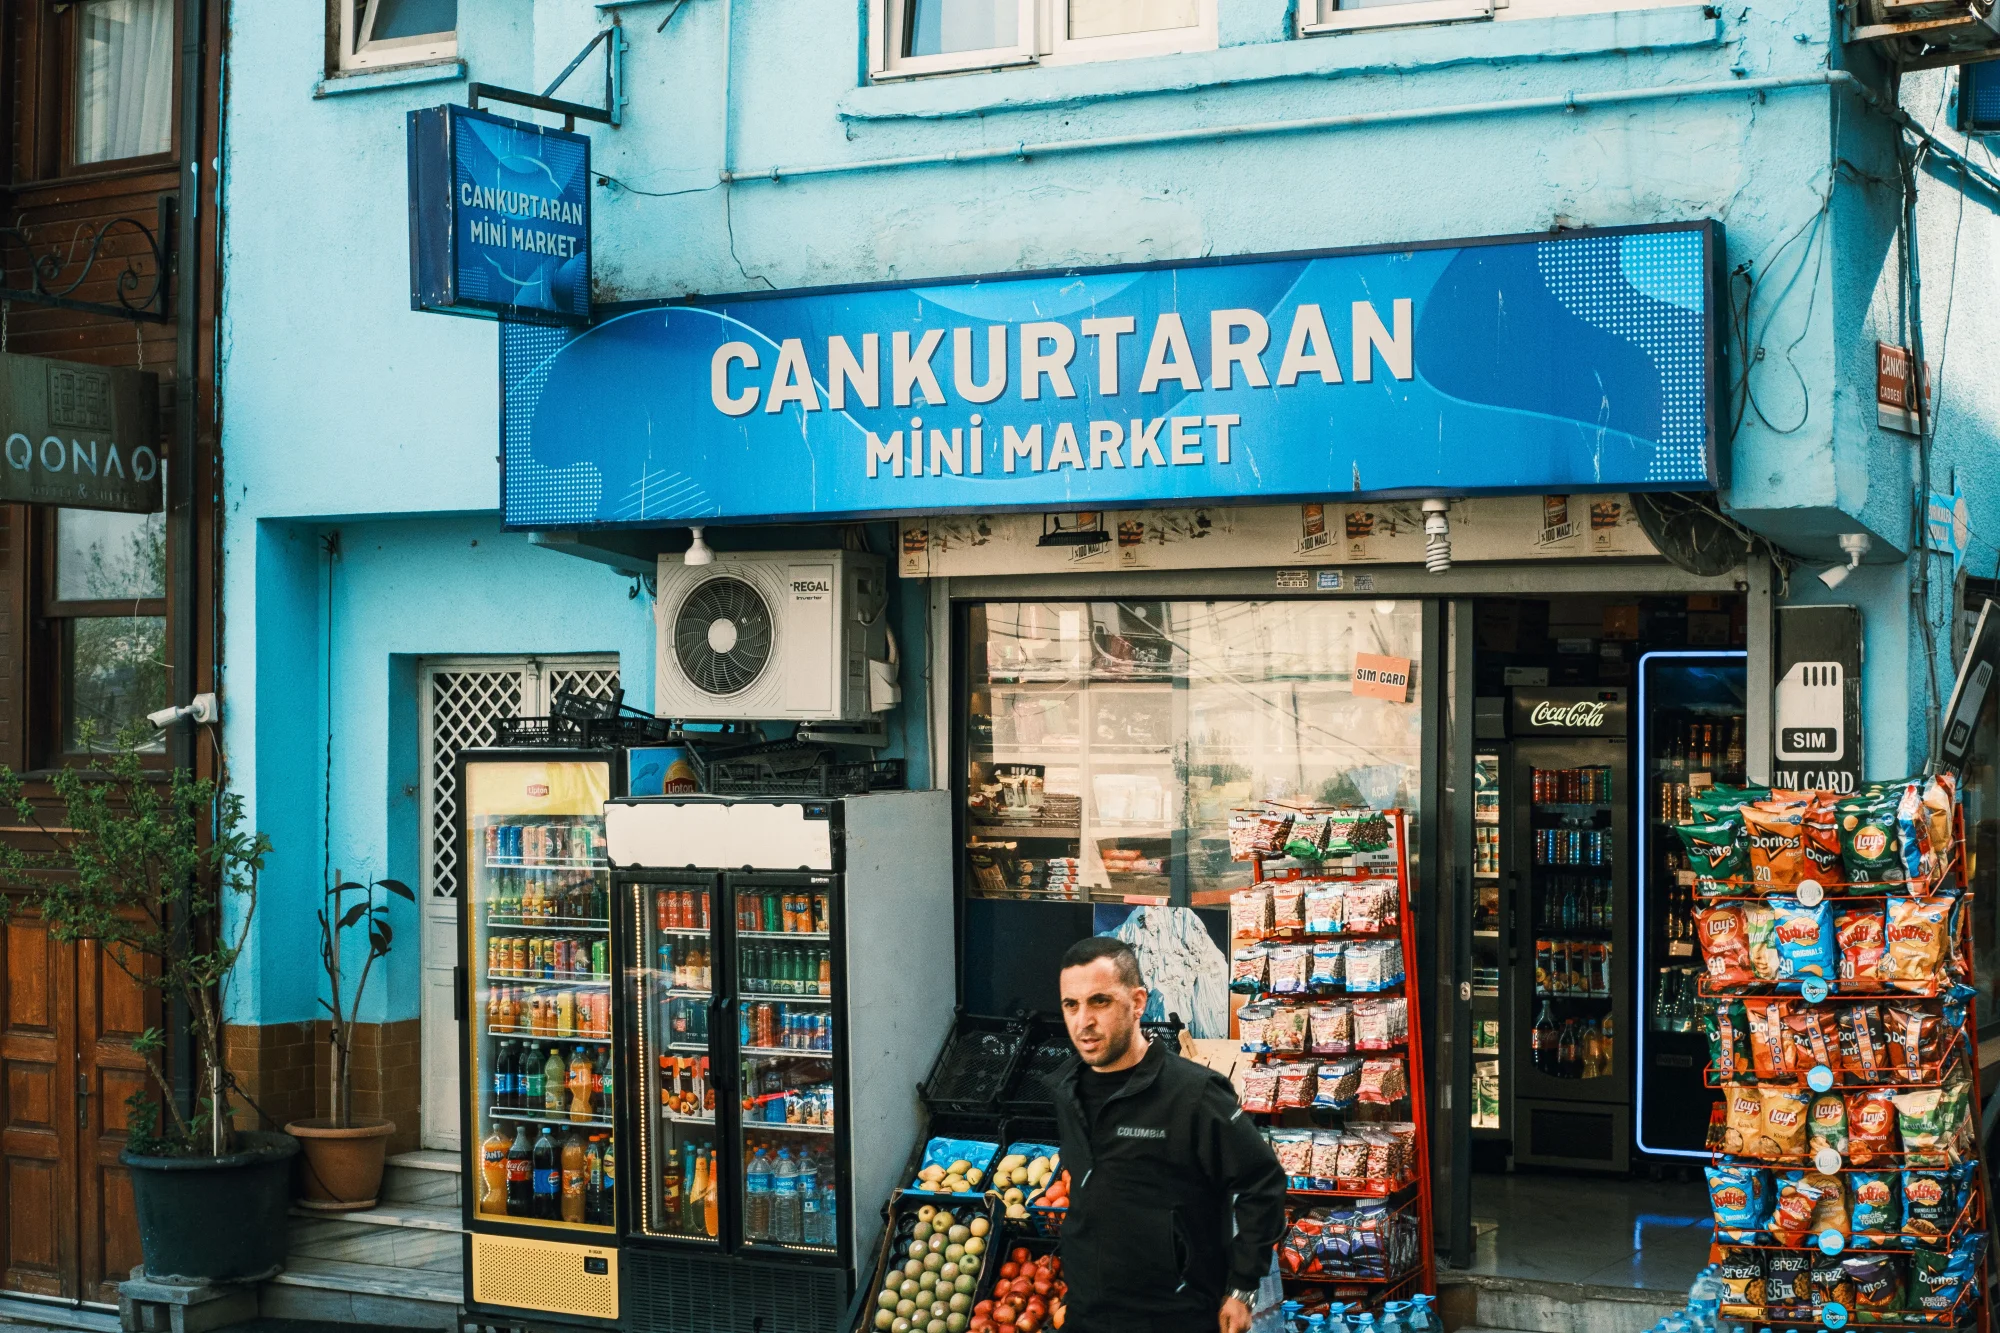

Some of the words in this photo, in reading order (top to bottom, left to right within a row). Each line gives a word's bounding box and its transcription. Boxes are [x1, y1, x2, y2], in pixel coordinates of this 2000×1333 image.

[461, 183, 583, 226] CANKURTARAN
[470, 216, 507, 248] MİNİ
[511, 226, 577, 259] MARKET
[711, 298, 1415, 416] CANKURTARAN
[866, 413, 983, 478] MİNİ
[1003, 413, 1242, 473] MARKET
[793, 582, 829, 592] REGAL
[1356, 668, 1377, 682] SIM
[1379, 671, 1406, 686] CARD
[1530, 701, 1607, 727] Coca-Cola
[1793, 732, 1826, 749] SIM
[528, 785, 548, 795] Lipton
[667, 782, 694, 794] Lipton
[1773, 770, 1799, 792] IM
[1803, 770, 1855, 794] CARD
[1750, 835, 1800, 849] Doritos
[1856, 834, 1884, 851] Lay's
[1755, 866, 1771, 882] 20
[1853, 869, 1869, 882] 20
[1709, 916, 1736, 936] Lay's
[1775, 922, 1820, 945] Ruffles
[1887, 923, 1934, 943] Ruffles
[1839, 961, 1855, 979] 20
[1735, 1098, 1760, 1115] Lay's
[1815, 1103, 1843, 1120] Lay's
[1770, 1108, 1797, 1126] Lay's
[1862, 1110, 1886, 1127] Lay's
[1712, 1191, 1747, 1208] Ruffles
[1918, 1271, 1959, 1286] Doritos
[1768, 1279, 1783, 1299] 35
